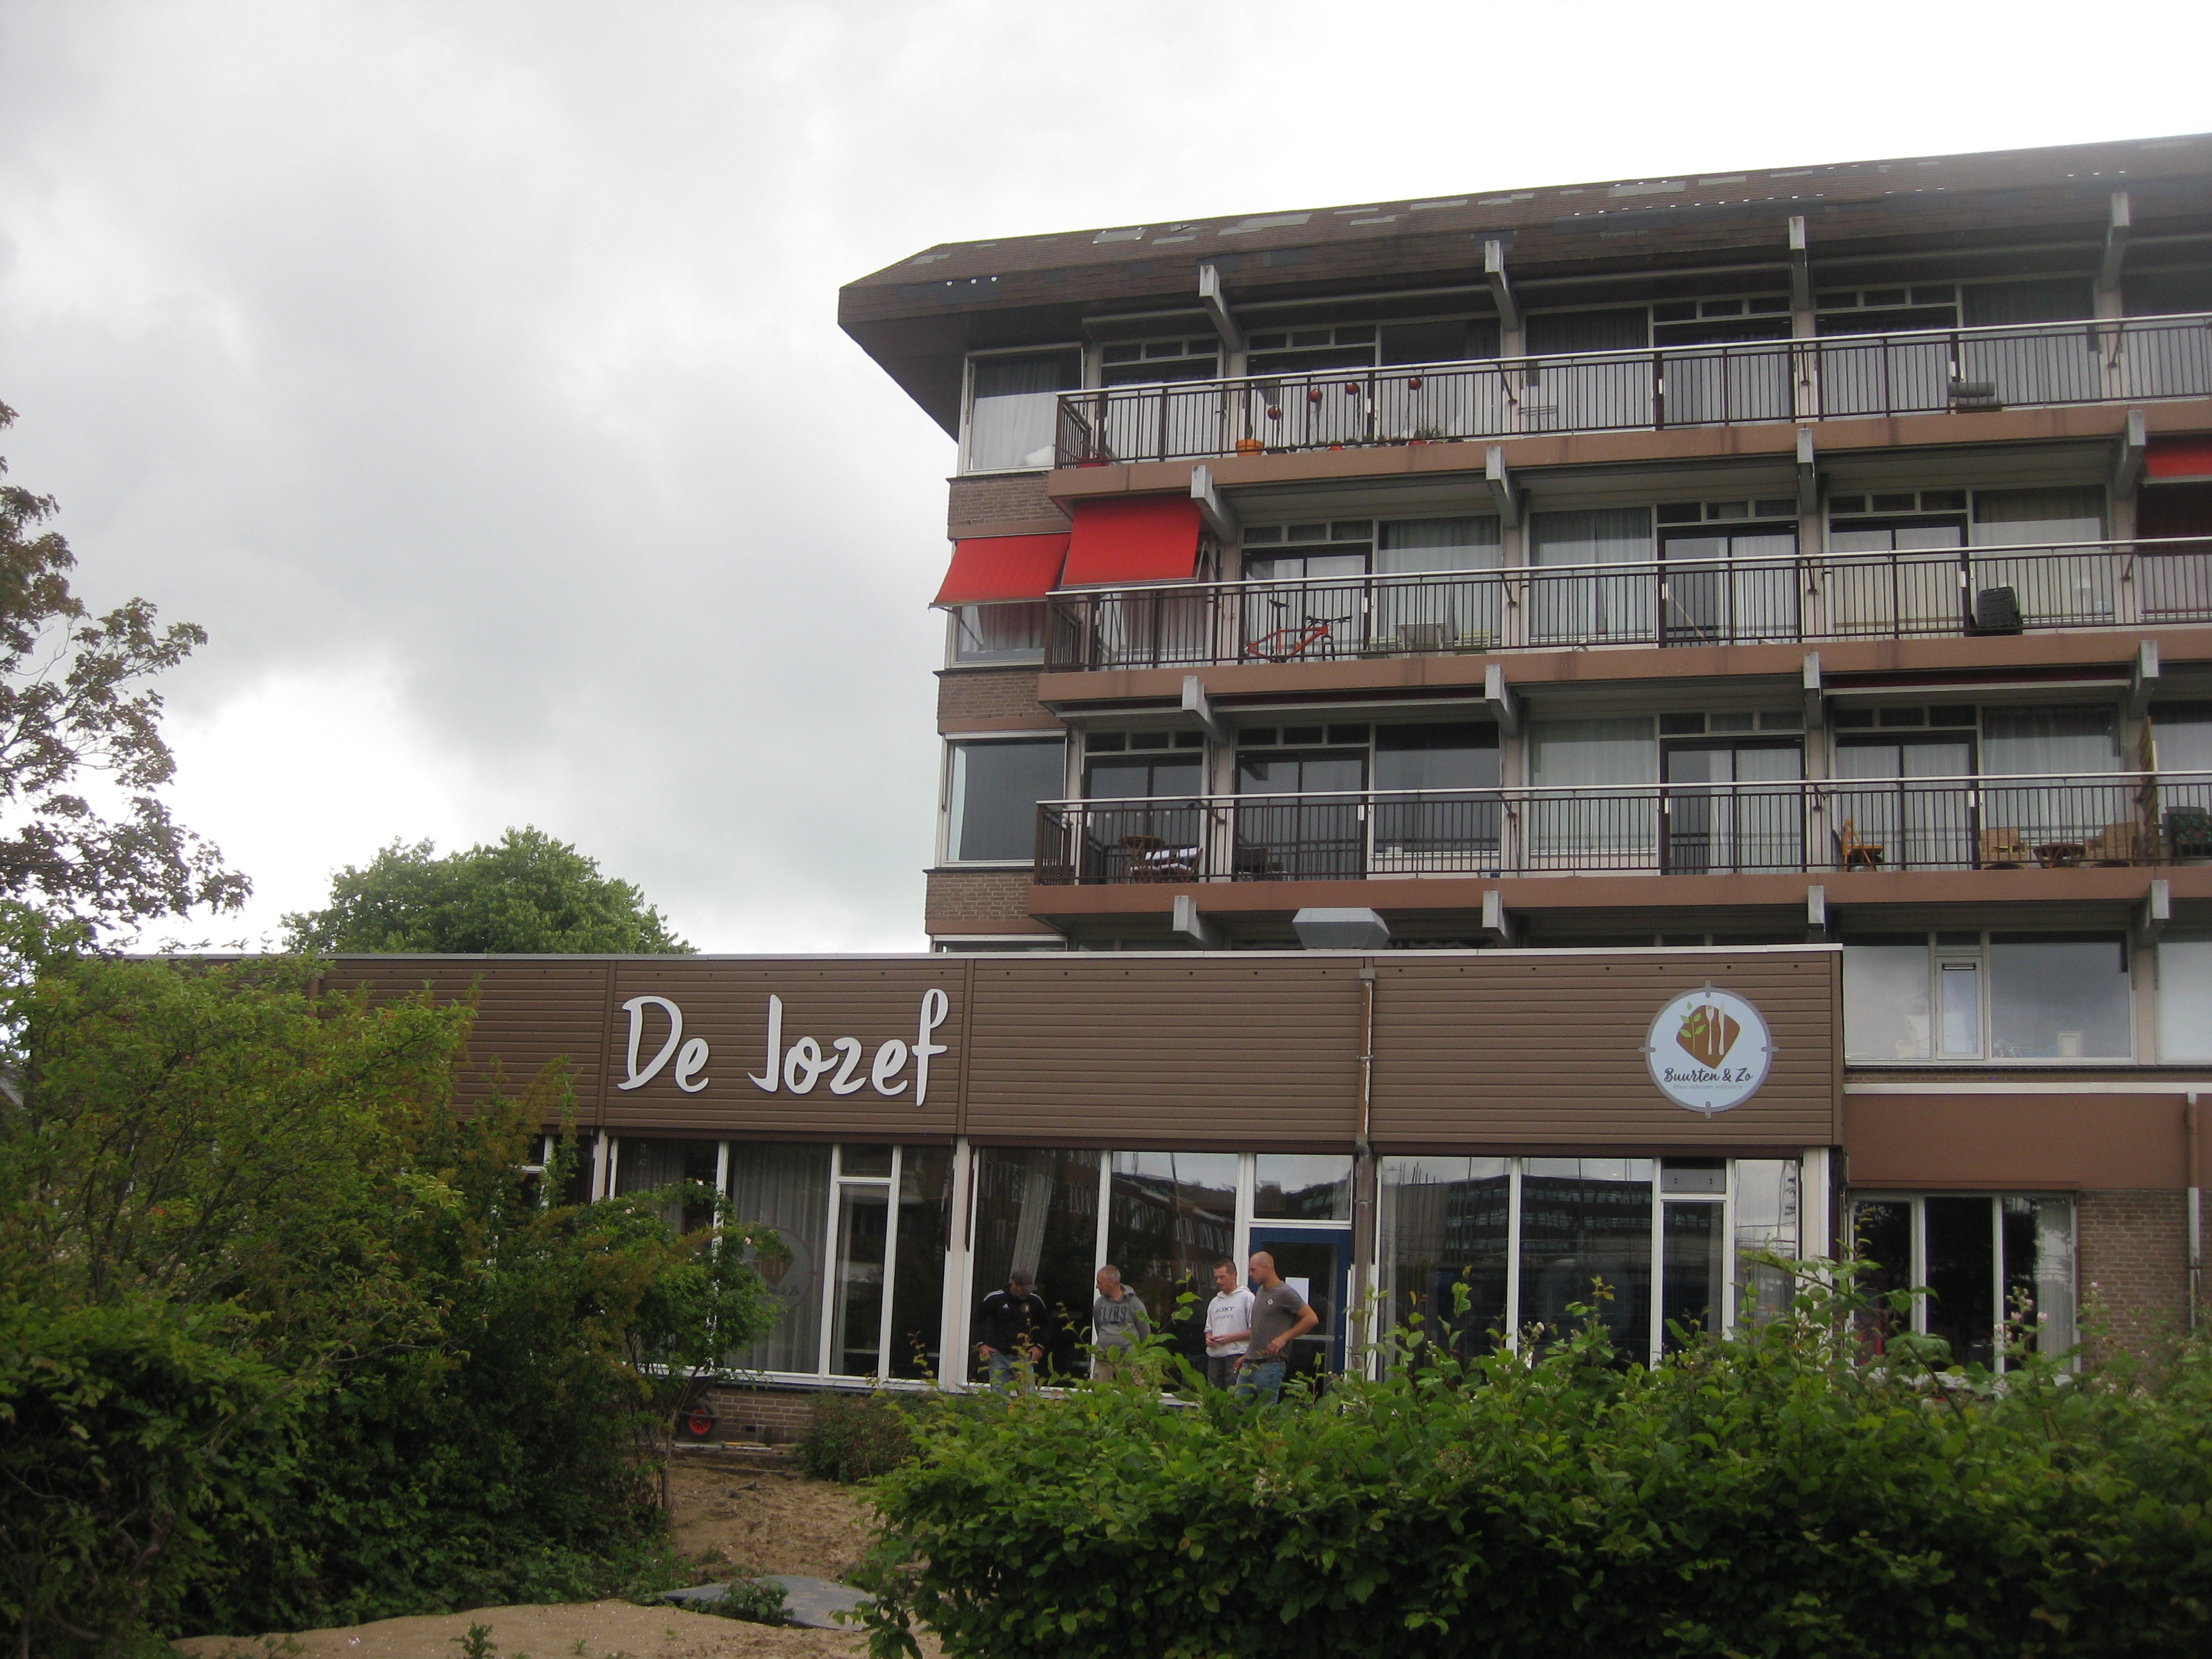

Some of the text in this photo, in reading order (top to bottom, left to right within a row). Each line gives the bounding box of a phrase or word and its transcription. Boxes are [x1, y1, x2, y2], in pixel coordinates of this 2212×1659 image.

[617, 987, 949, 1107] De Jozef
[1663, 1067, 1753, 1083] Buurten & Zo
